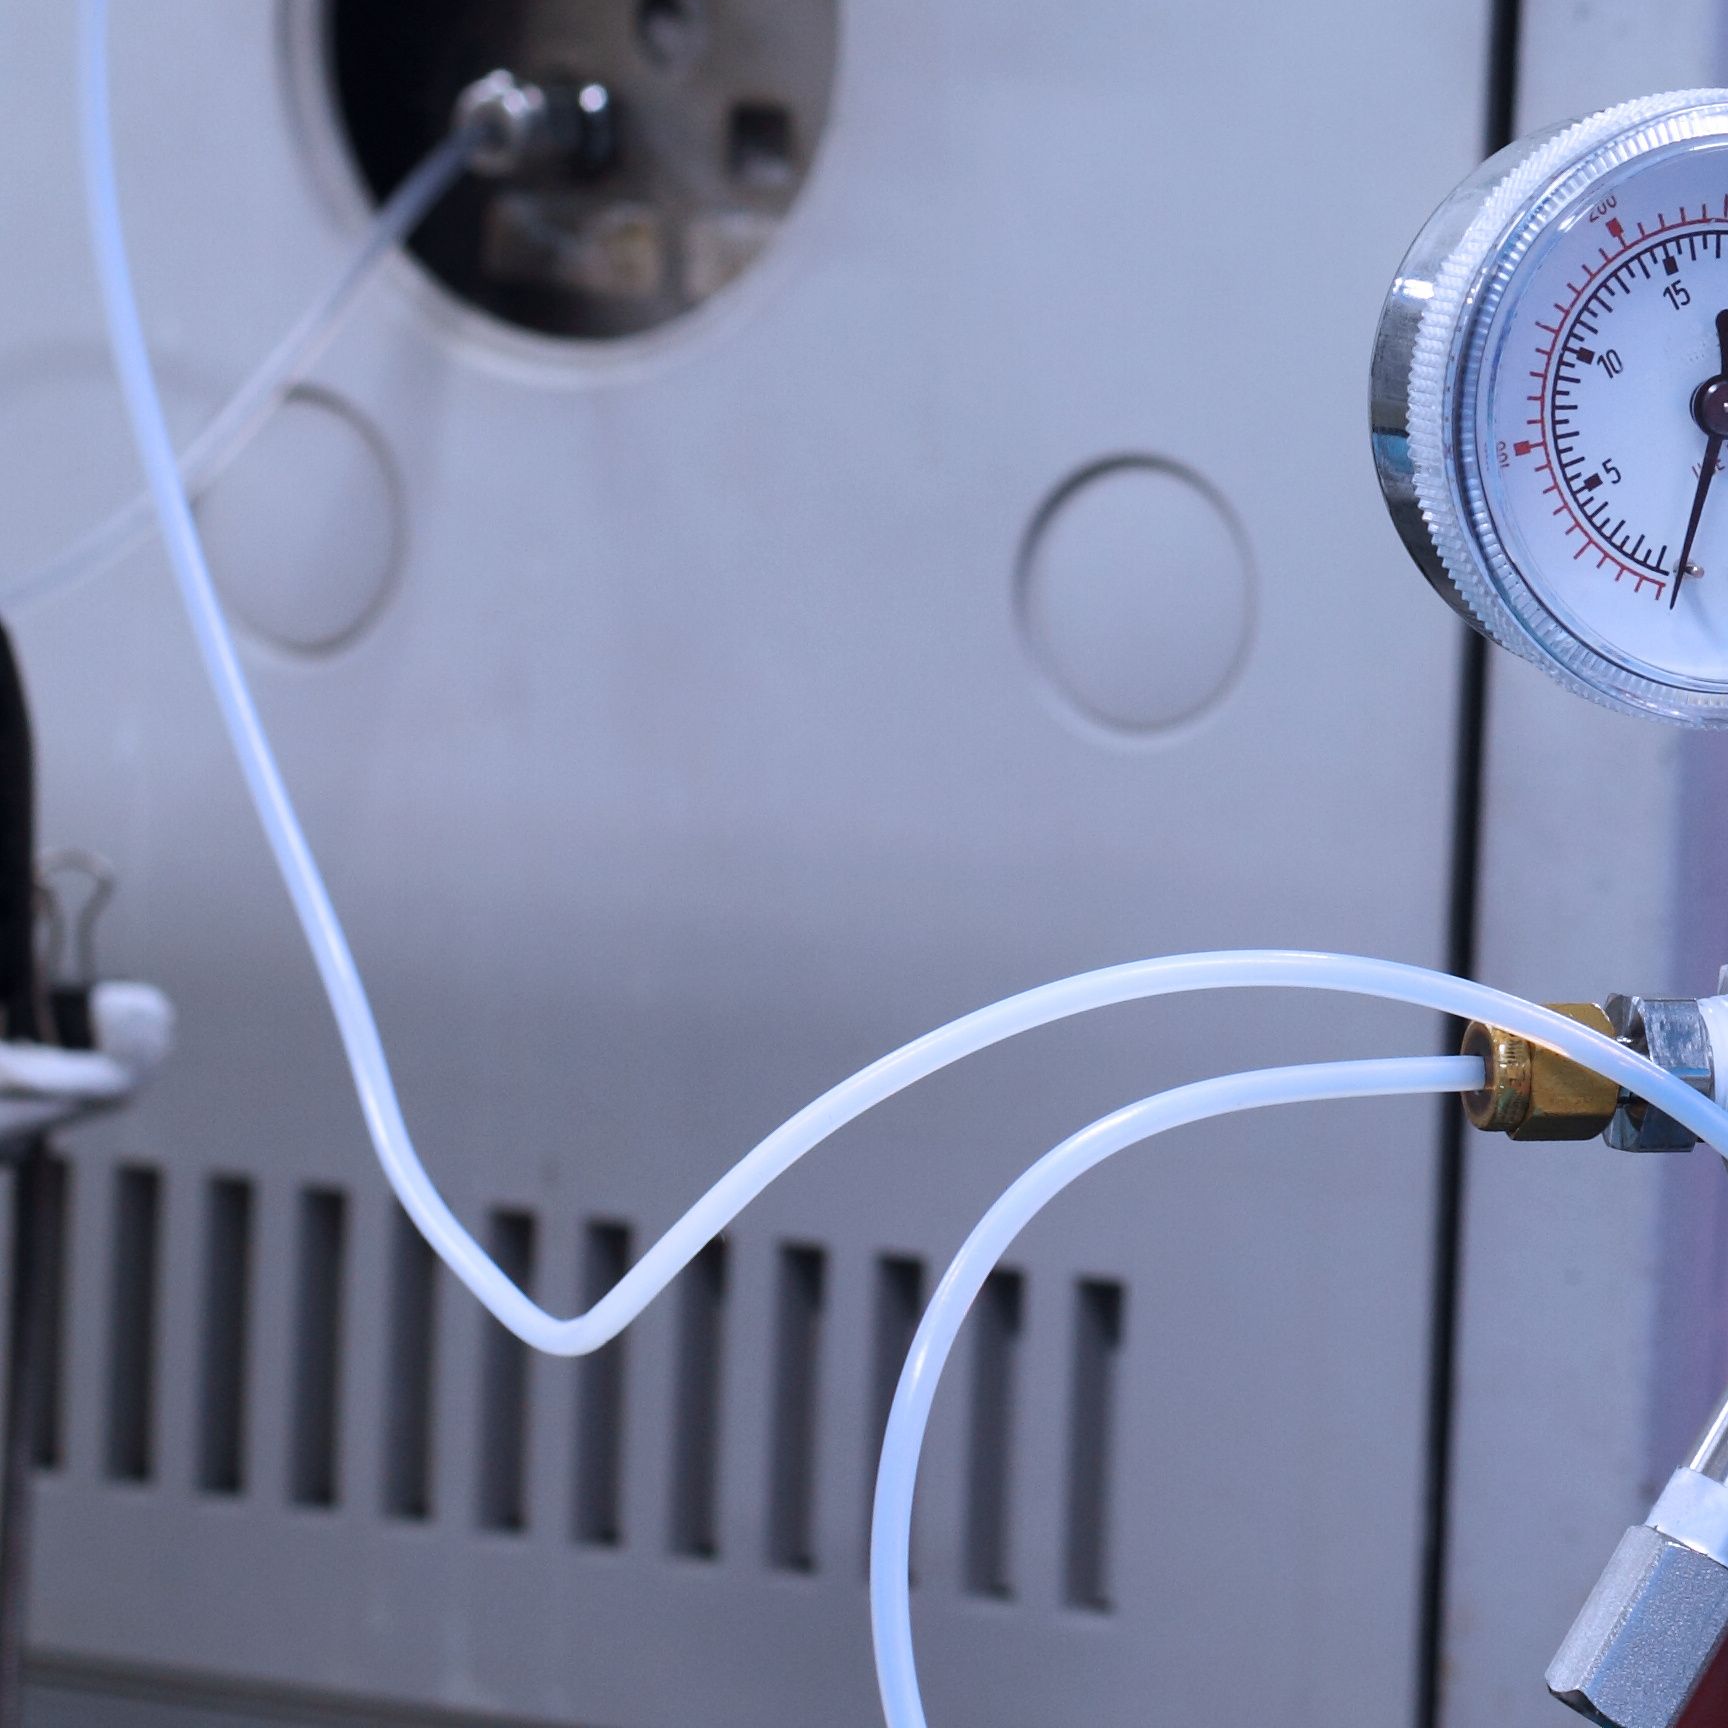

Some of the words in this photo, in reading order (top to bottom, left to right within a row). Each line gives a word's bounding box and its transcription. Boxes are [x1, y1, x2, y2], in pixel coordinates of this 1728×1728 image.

[1663, 279, 1691, 310] 15
[1597, 349, 1624, 379] 10
[1602, 458, 1621, 484] 5
